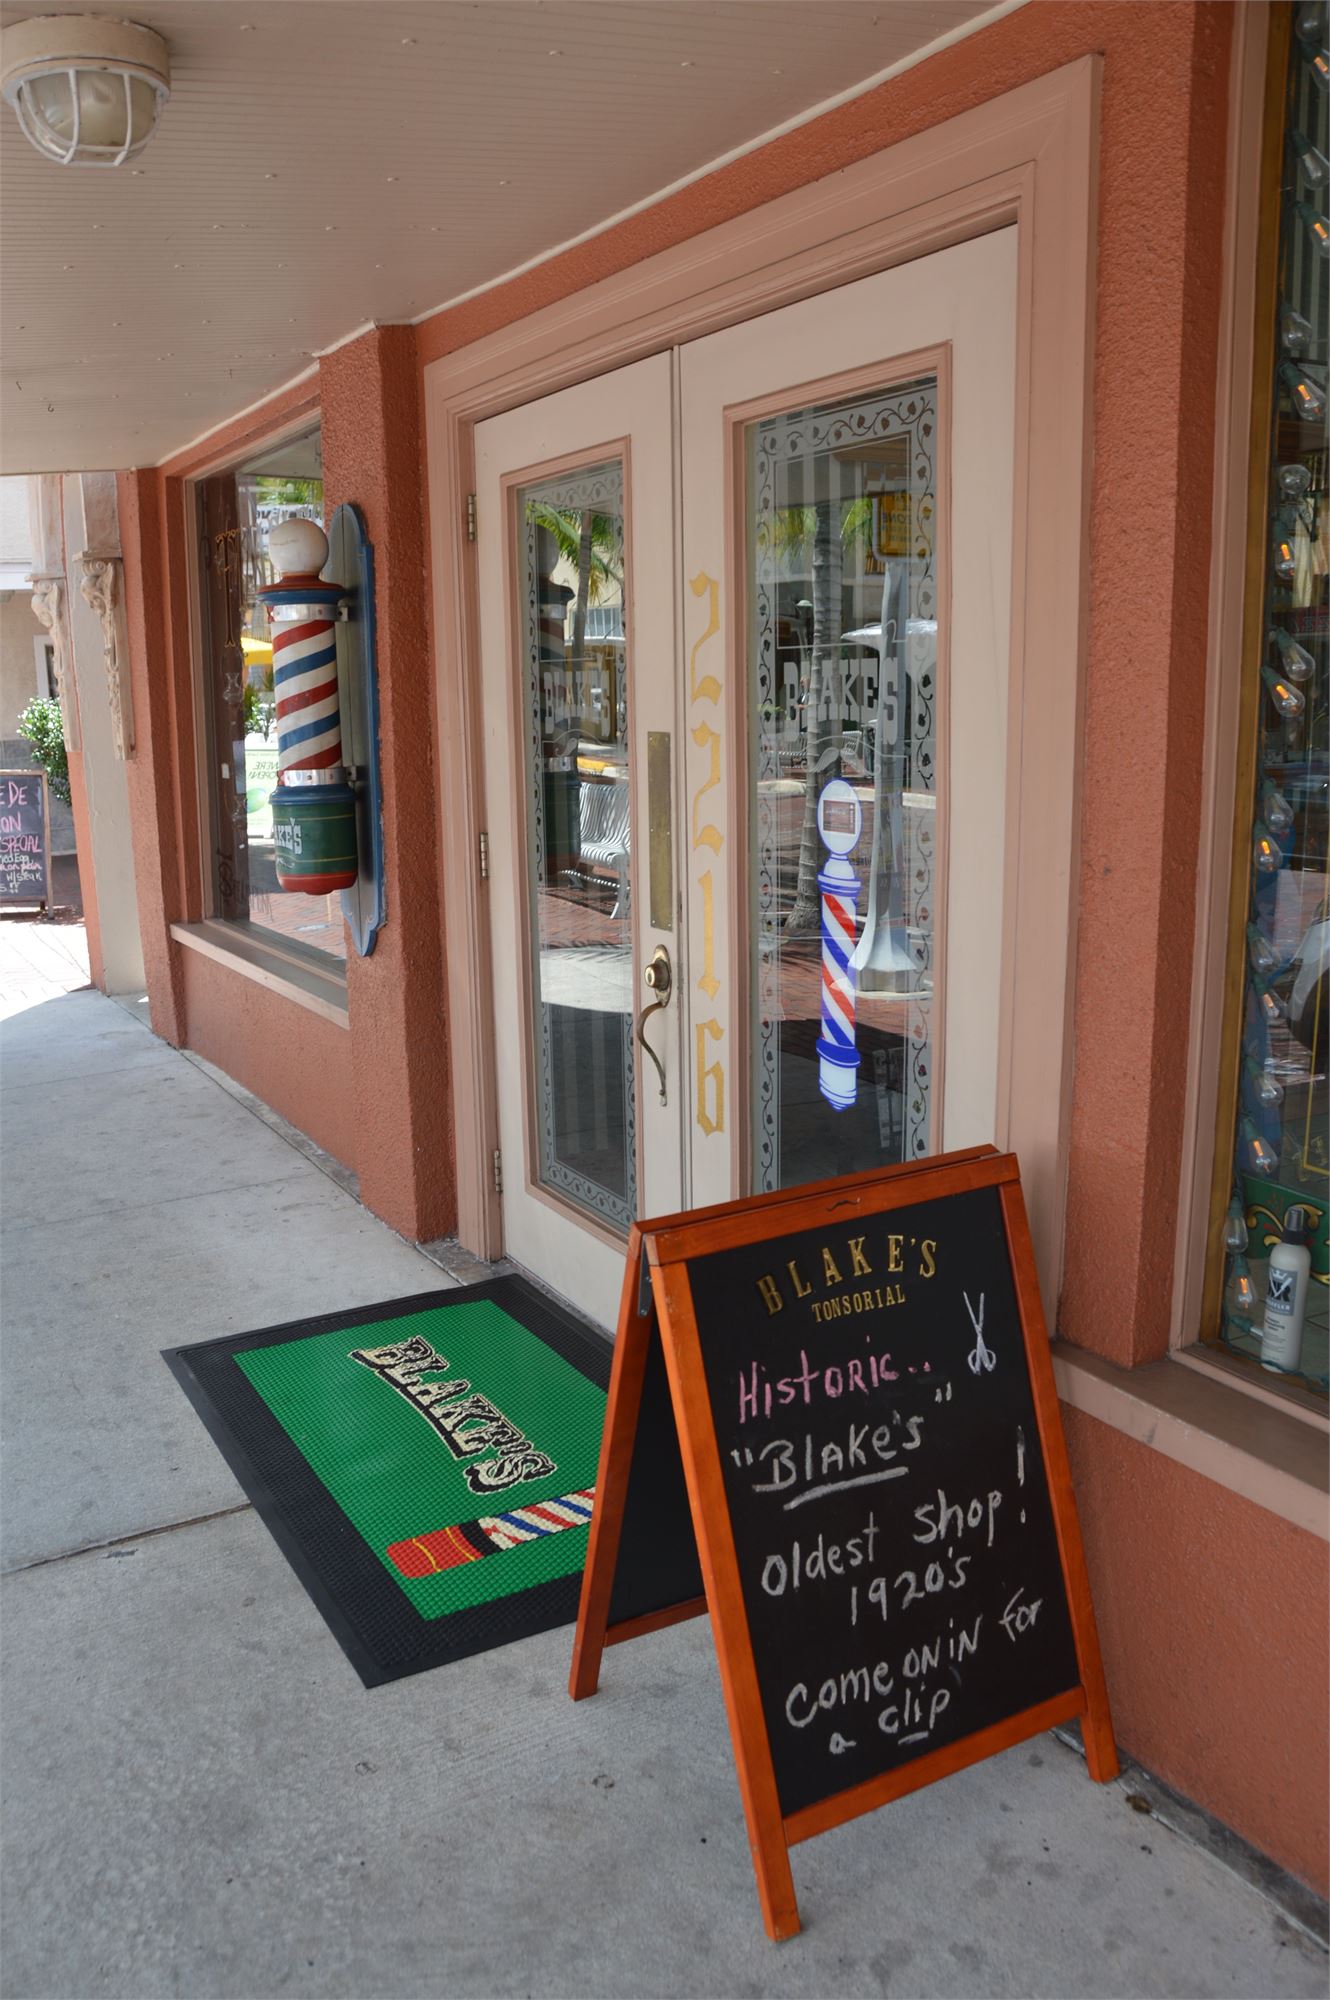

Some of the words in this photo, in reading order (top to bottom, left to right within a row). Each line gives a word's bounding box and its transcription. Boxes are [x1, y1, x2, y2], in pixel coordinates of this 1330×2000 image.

[756, 1234, 937, 1316] BLAKE'S
[811, 1284, 906, 1323] TONSORIAL
[347, 1335, 558, 1495] BLAKE'S
